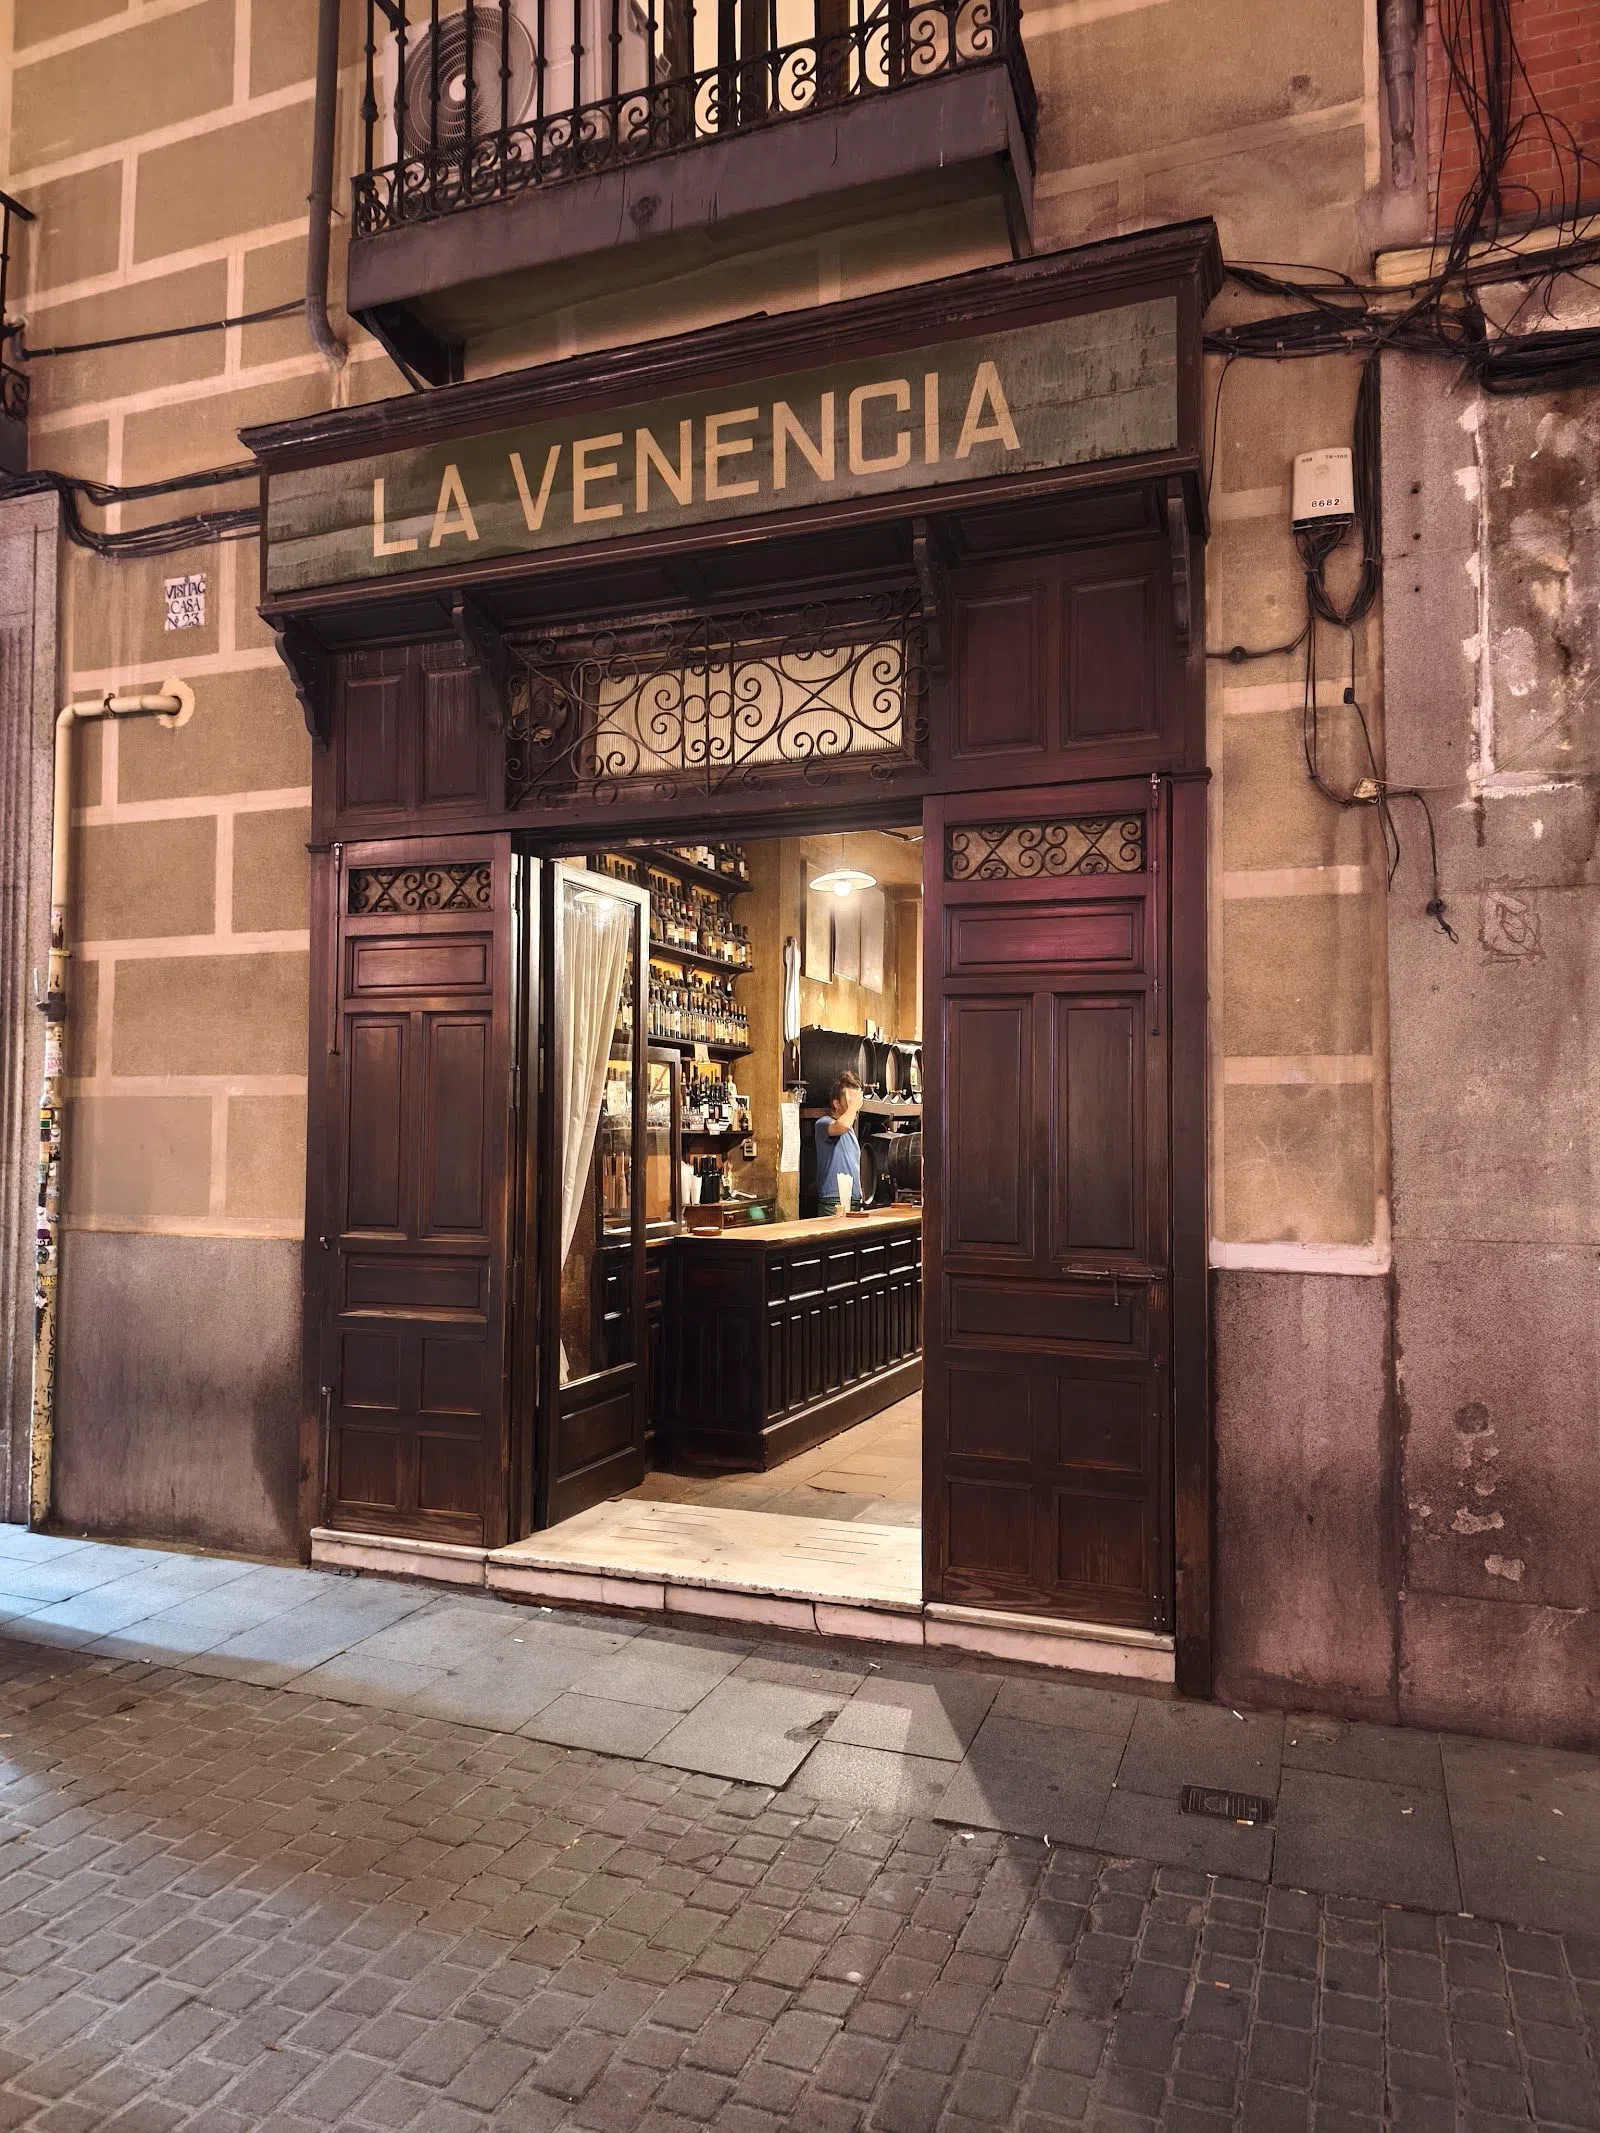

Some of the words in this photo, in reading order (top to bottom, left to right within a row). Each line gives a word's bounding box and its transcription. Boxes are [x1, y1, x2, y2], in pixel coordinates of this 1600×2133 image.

[372, 465, 479, 557] LA
[509, 361, 1021, 532] VENENCIA
[171, 598, 201, 614] CASA
[181, 612, 199, 628] 23
